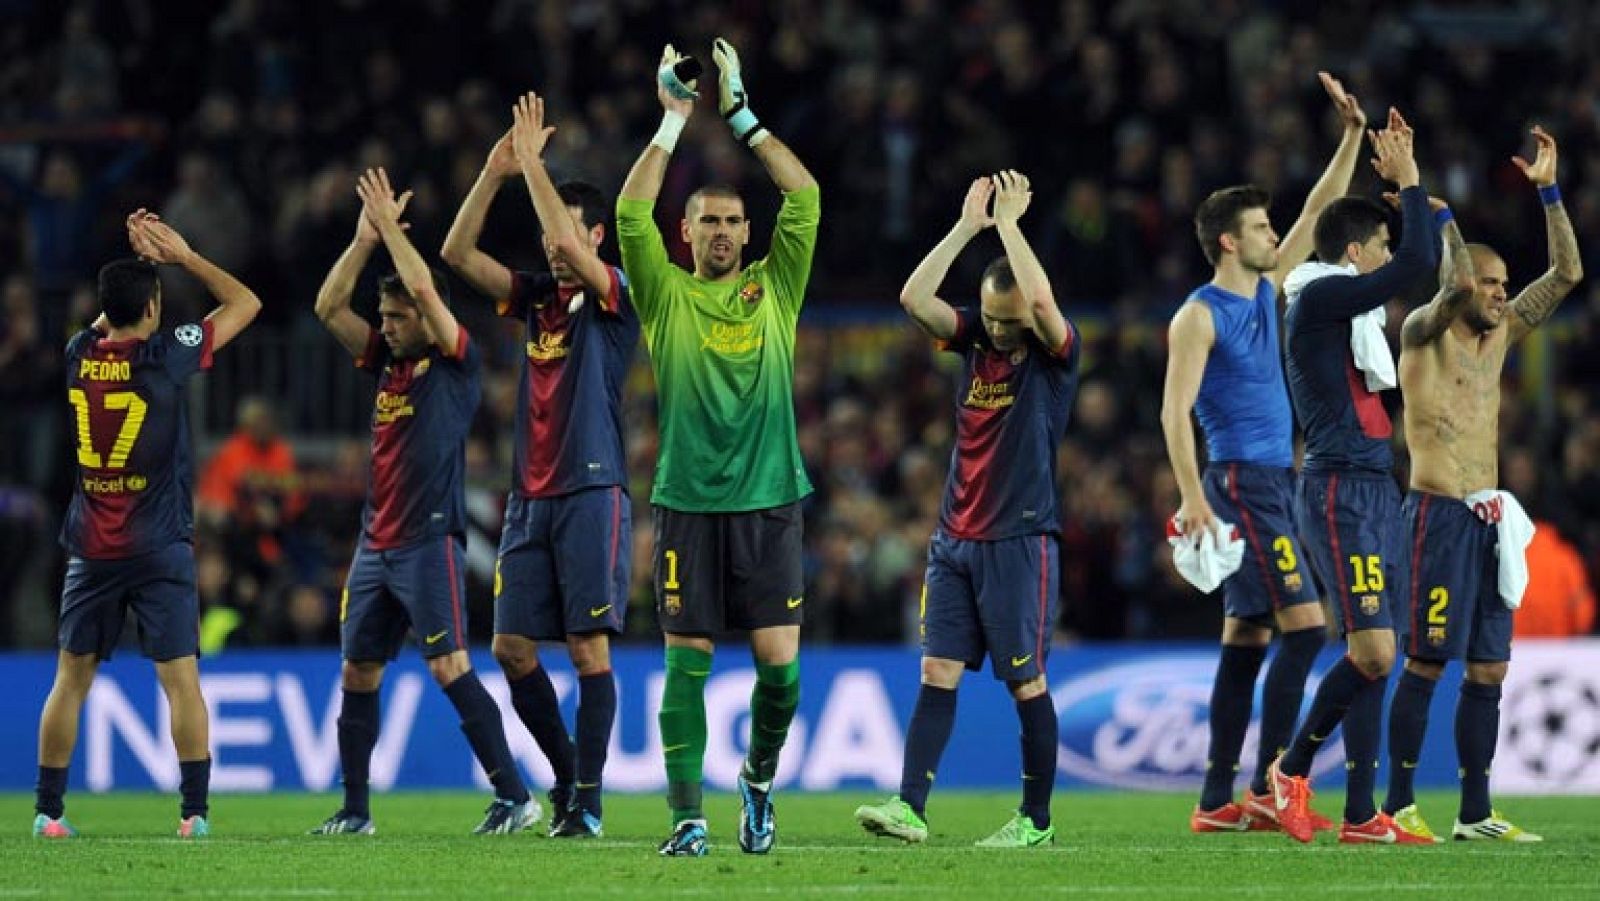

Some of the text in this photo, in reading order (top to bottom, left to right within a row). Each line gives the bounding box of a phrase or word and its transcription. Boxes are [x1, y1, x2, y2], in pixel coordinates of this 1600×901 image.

[79, 358, 131, 381] PEDRO
[68, 388, 148, 468] 17
[664, 549, 680, 589] 1
[1273, 536, 1296, 571] 3
[1350, 554, 1384, 593] 15
[1428, 587, 1449, 625] 2
[86, 670, 424, 793] NEW
